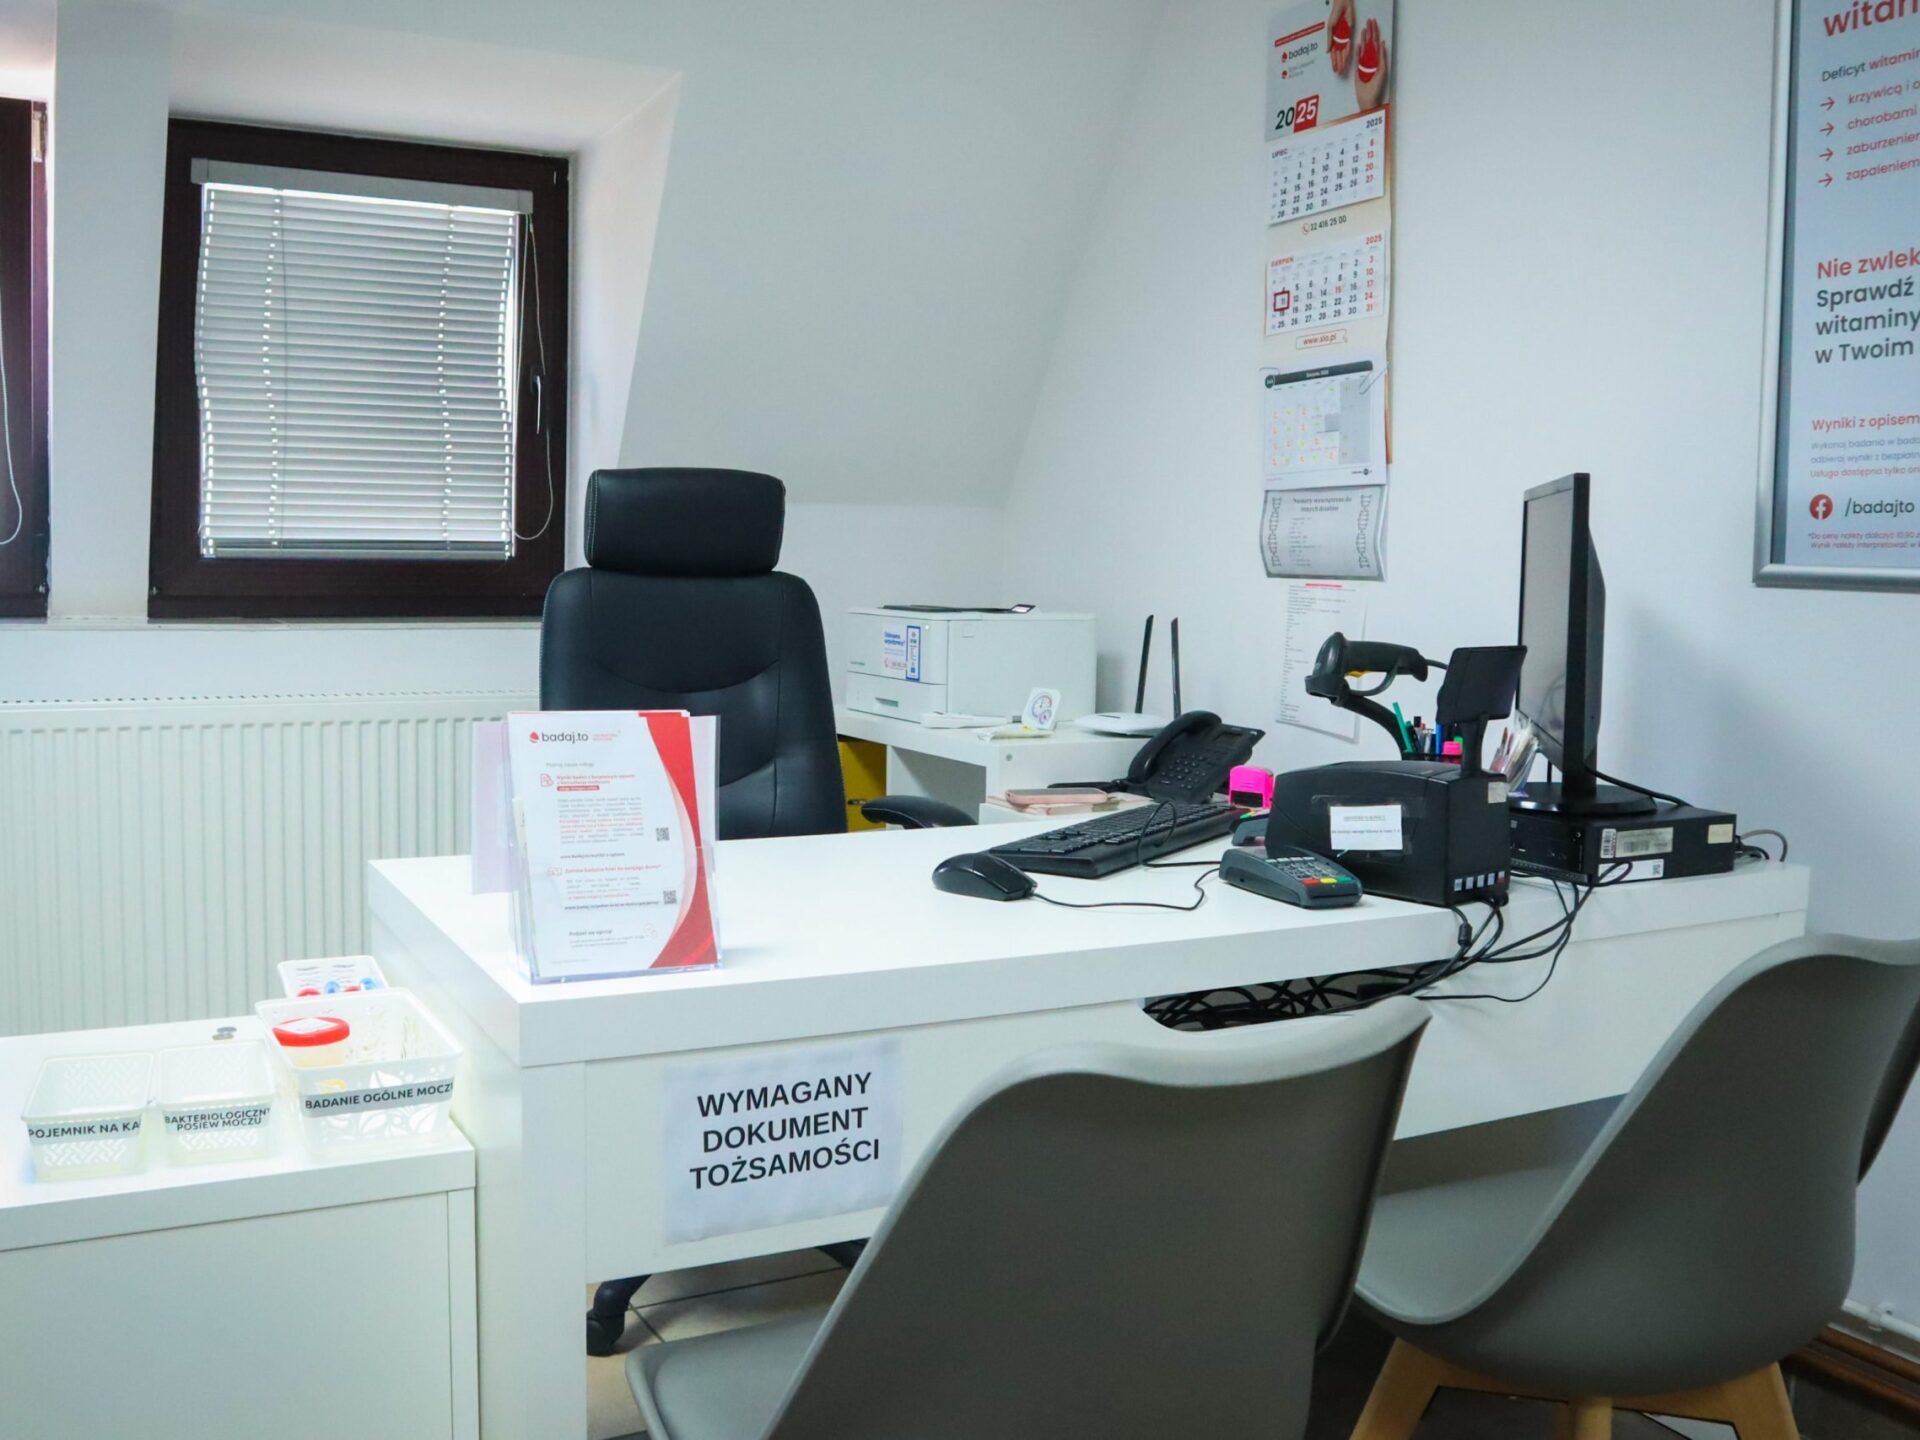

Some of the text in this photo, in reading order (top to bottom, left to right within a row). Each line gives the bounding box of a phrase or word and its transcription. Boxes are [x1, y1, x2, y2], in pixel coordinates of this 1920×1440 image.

[1289, 42, 1318, 60] badaj.to
[1822, 61, 1866, 82] Deficyt
[1848, 84, 1903, 104] krzywicą
[1906, 80, 1910, 91] i
[1275, 98, 1318, 130] 2025
[1366, 116, 1383, 128] 2025
[1847, 104, 1918, 130] chorobami
[1846, 158, 1920, 181] zapaleniem
[1329, 217, 1337, 226] 25
[1339, 215, 1347, 224] 00
[1818, 247, 1920, 279] Nie zwlek
[1817, 275, 1914, 312] Sprawdź
[1816, 308, 1920, 336] witaminy
[1815, 337, 1914, 364] w Twoim
[1811, 413, 1920, 433] Wyniki z opisem
[1844, 497, 1915, 517] /badajto
[541, 731, 589, 745] badaj.to
[305, 1095, 360, 1110] BADANIE
[363, 1088, 414, 1103] OGÓLNE
[697, 1071, 872, 1118] WYMAGANY
[99, 1123, 119, 1133] NA
[177, 1117, 262, 1131] POSIEW MOCZU
[703, 1106, 869, 1153] DOKUMENT
[689, 1137, 879, 1190] TOŻSAMOŚCI
